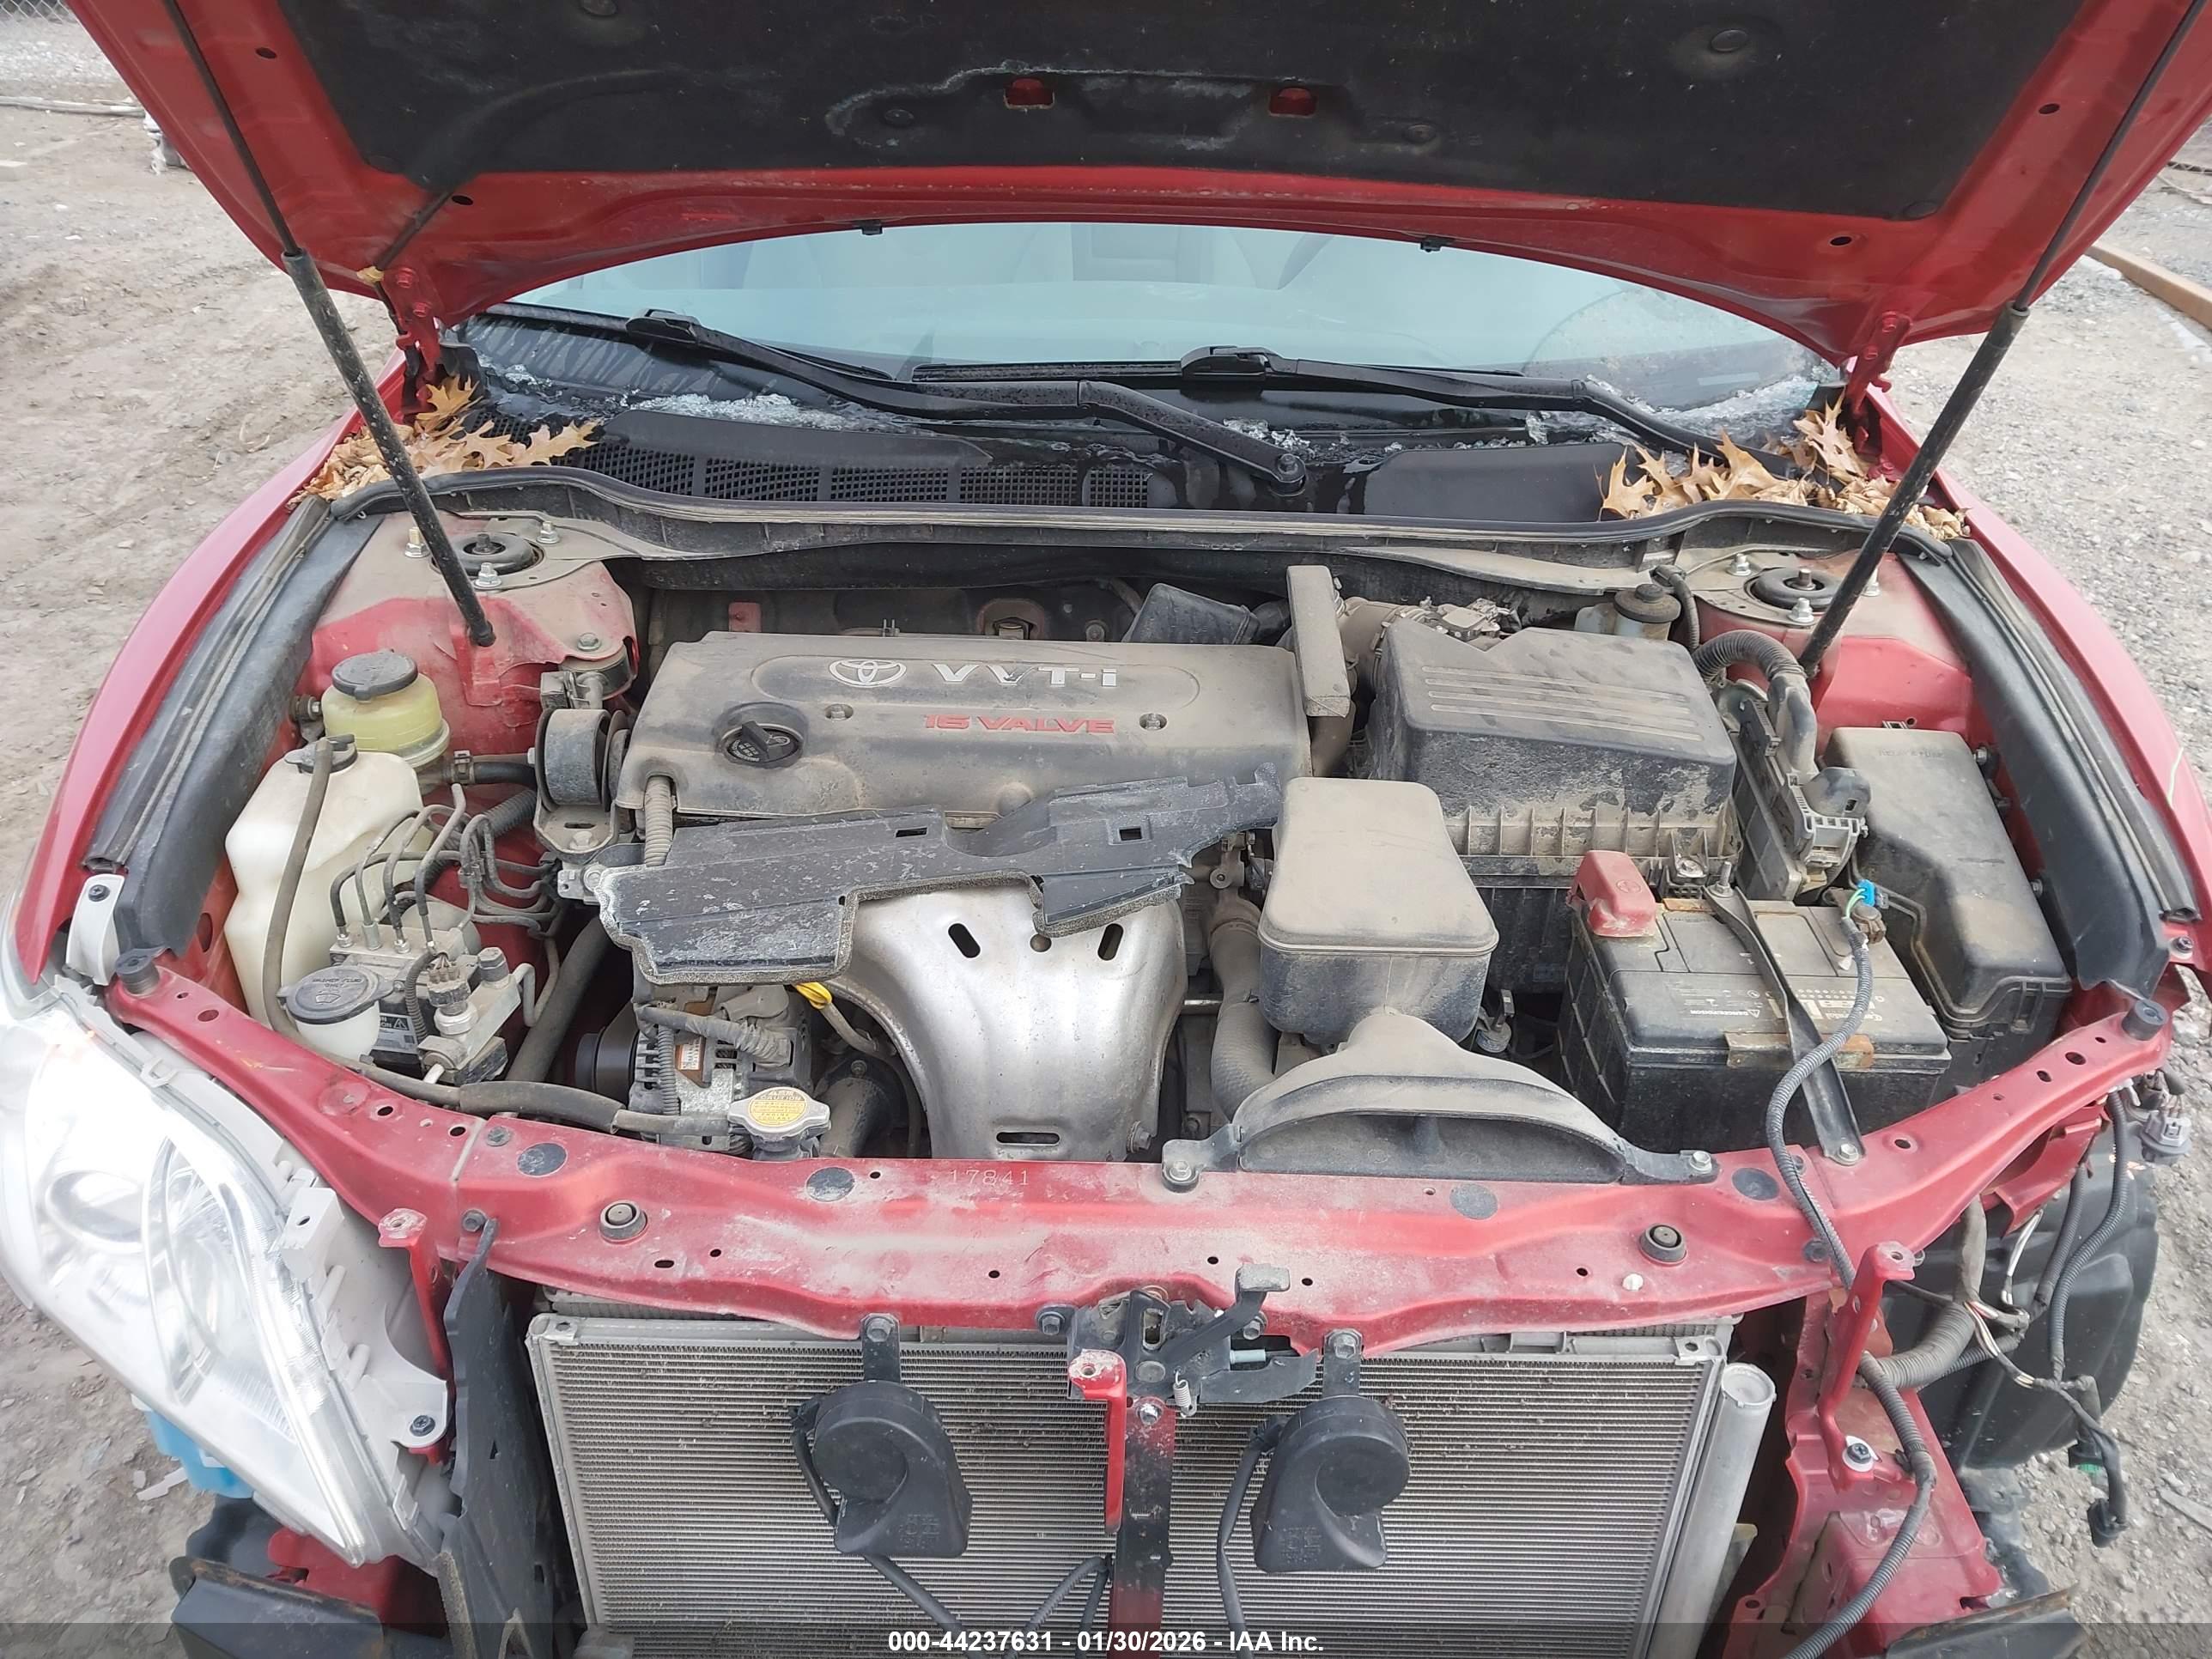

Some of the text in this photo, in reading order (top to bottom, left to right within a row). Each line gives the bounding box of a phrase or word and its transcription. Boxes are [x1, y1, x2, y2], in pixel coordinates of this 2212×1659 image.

[925, 714, 1115, 734] 16 VALVE
[950, 1169, 1030, 1187] 17841
